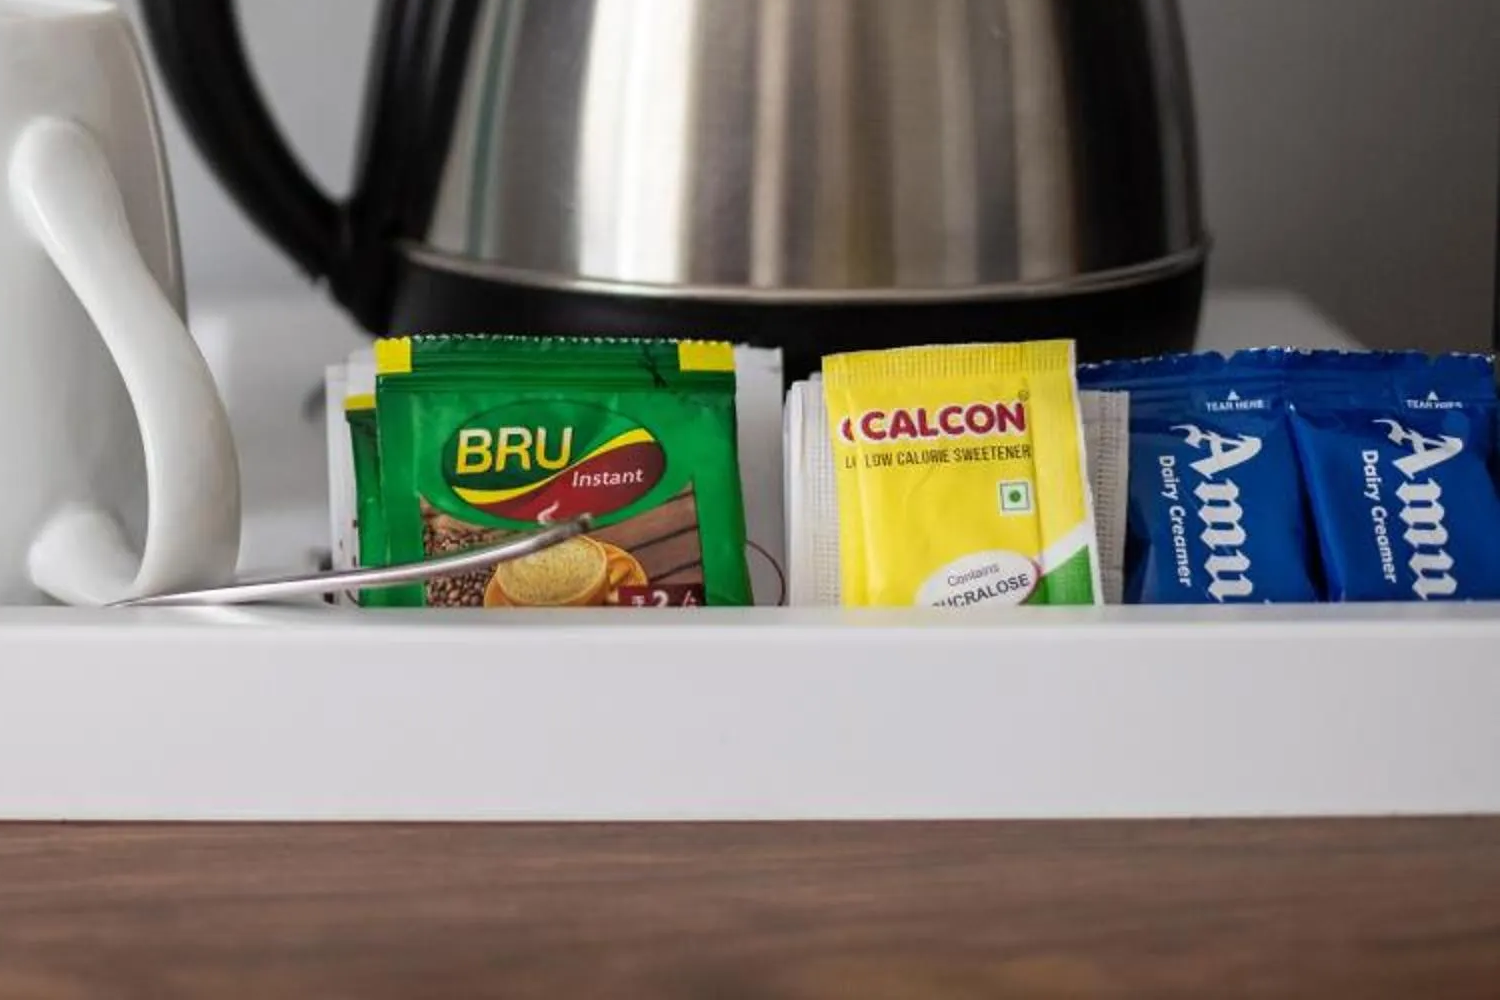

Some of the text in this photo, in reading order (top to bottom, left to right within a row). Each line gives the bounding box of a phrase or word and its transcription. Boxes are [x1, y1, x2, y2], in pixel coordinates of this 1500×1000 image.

[861, 402, 1026, 441] CALCON
[455, 426, 573, 475] BRU
[865, 451, 893, 468] LOW
[897, 447, 950, 466] CALORIE
[953, 444, 1032, 462] SWEETENER
[572, 467, 644, 489] Instant
[1158, 455, 1192, 588] Dairy Creamer
[1169, 424, 1263, 603] Amu
[1361, 449, 1397, 584] Dairy Creamer
[1372, 418, 1464, 601] Amu
[932, 573, 1031, 607] CRALOSE
